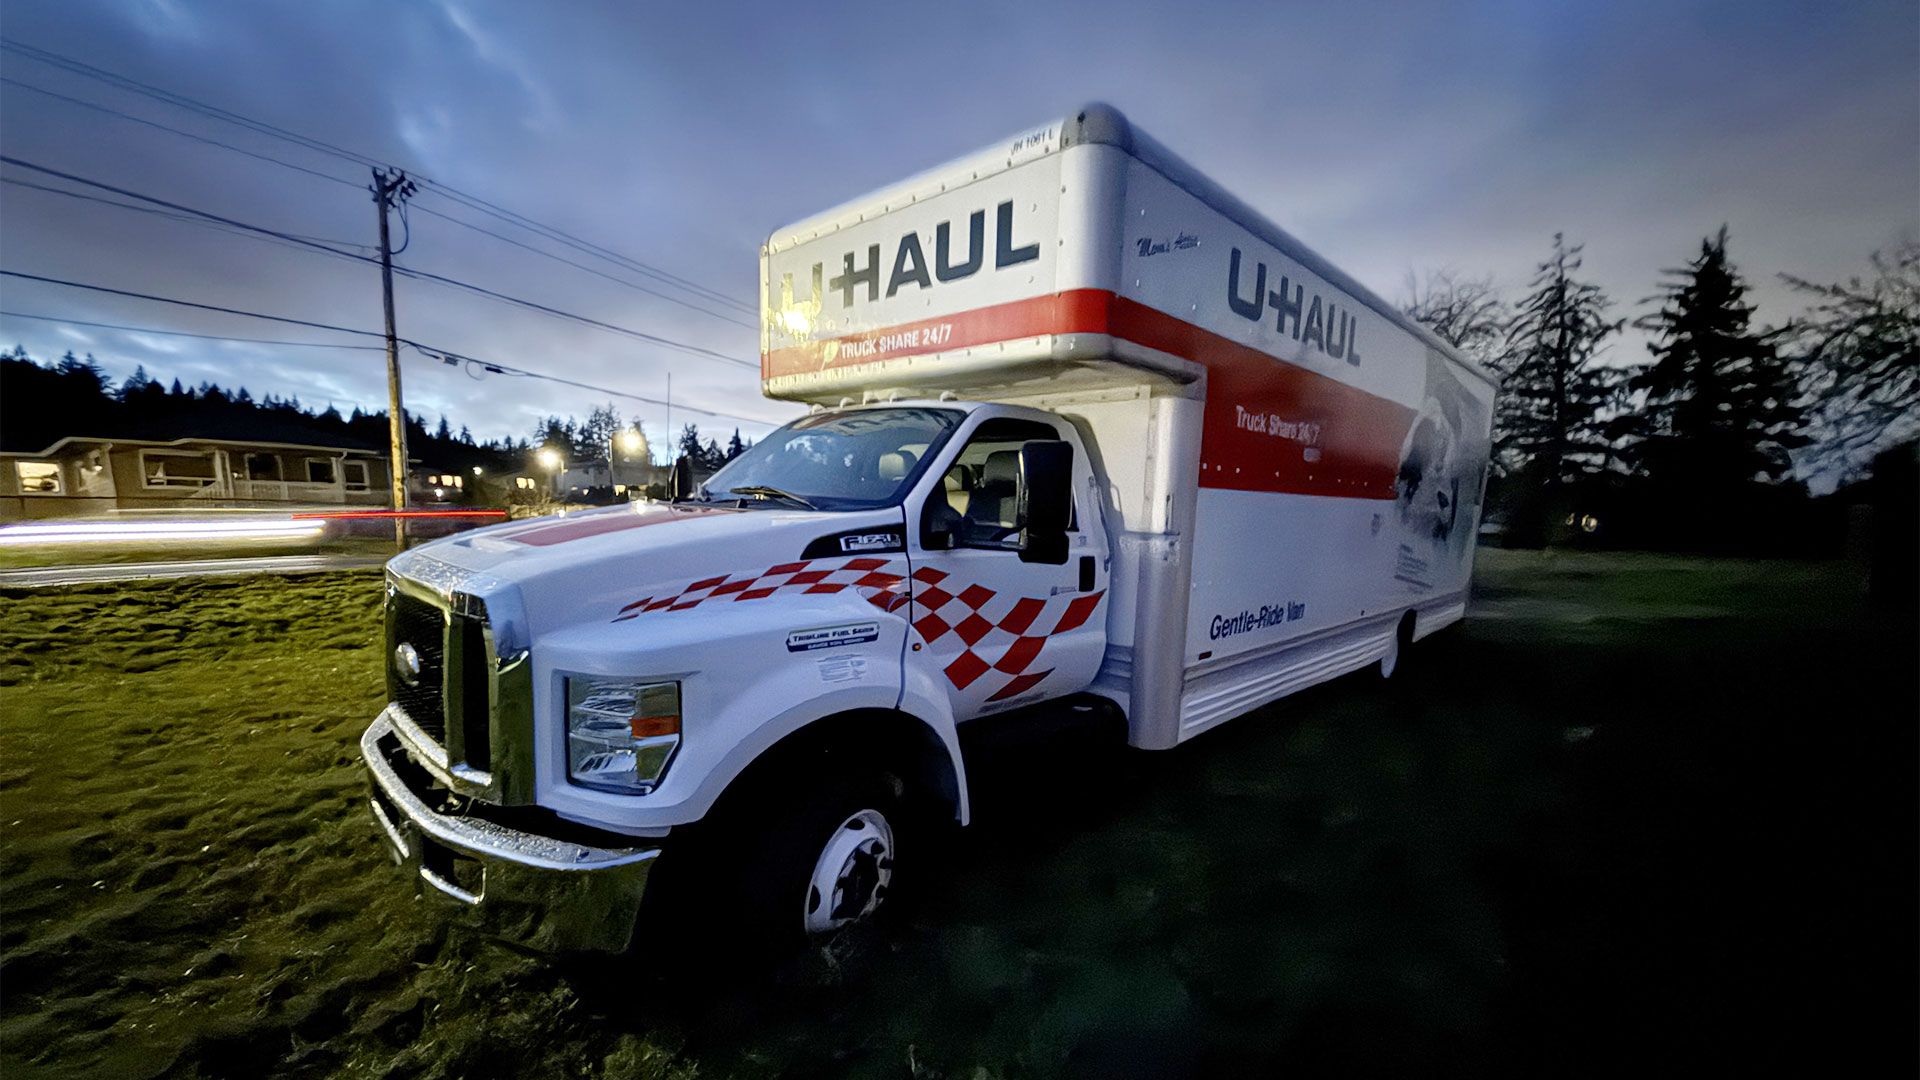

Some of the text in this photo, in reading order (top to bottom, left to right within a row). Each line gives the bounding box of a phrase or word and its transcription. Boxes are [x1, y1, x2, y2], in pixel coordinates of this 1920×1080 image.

[1228, 247, 1361, 368] U-HAUL
[841, 323, 952, 359] TRUCK SHARE 24/7
[1236, 404, 1267, 433] Truck
[1209, 604, 1284, 641] Gentle-Ride
